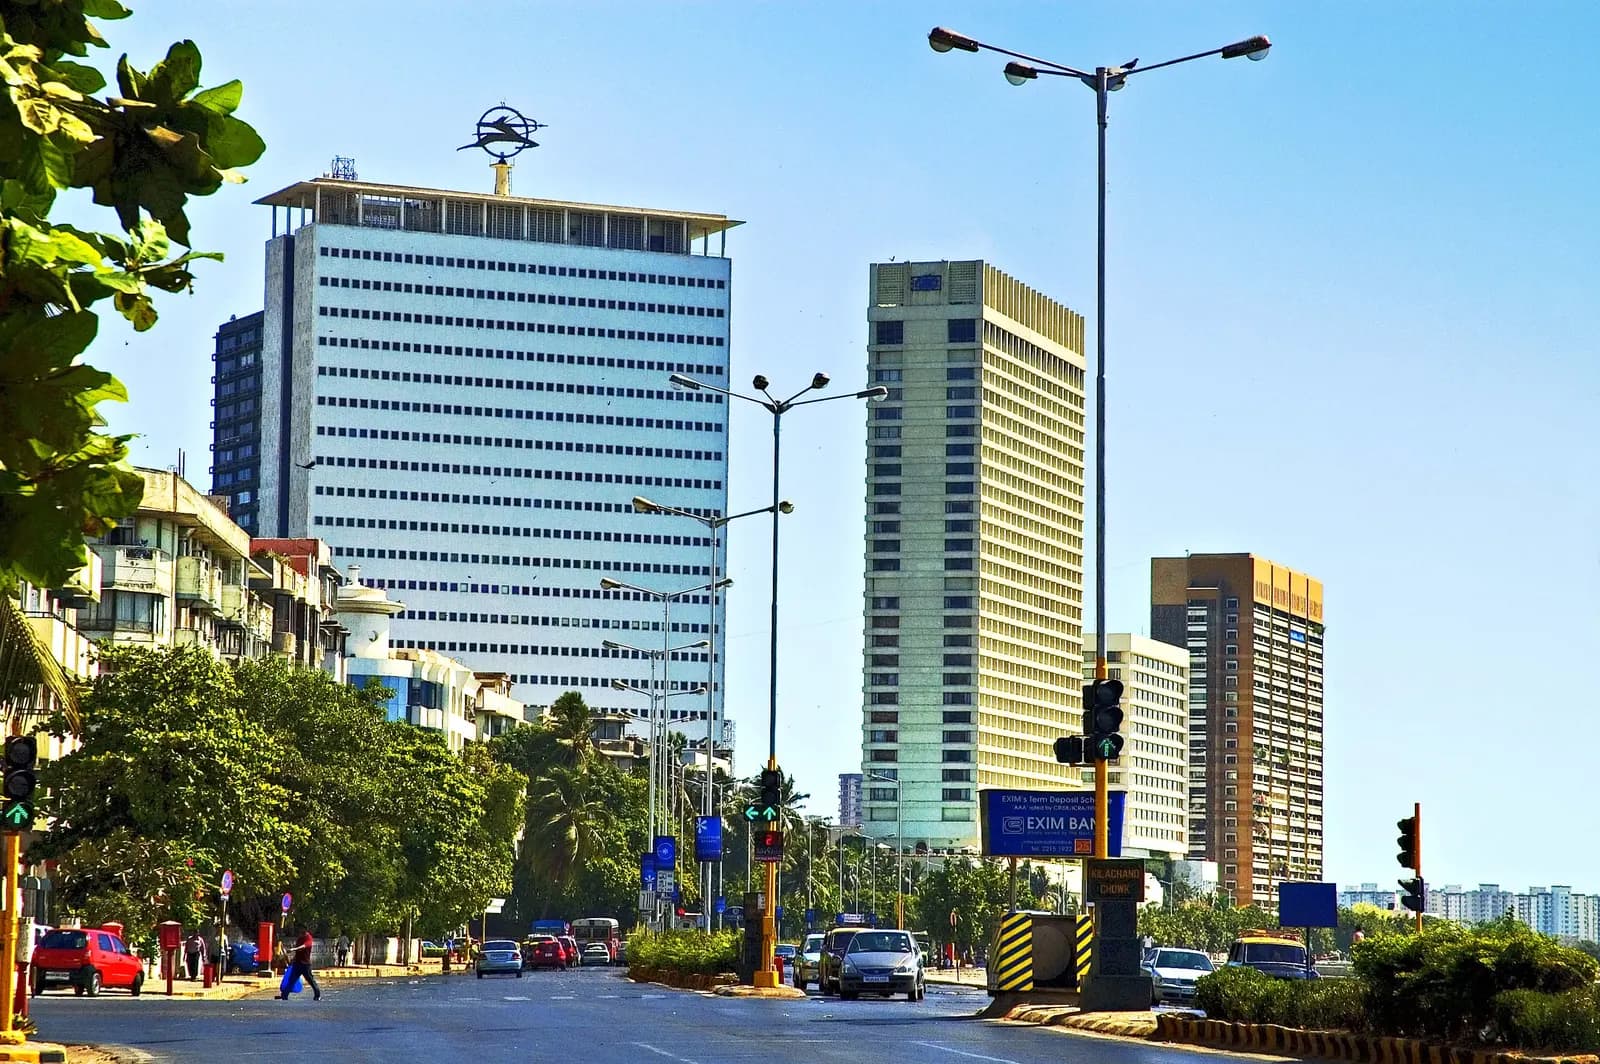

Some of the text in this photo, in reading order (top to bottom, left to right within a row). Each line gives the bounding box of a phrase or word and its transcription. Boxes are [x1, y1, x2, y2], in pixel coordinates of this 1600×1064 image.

[1029, 795, 1048, 803] Term
[1050, 795, 1079, 805] Deposit
[1027, 816, 1111, 831] EXIM BAN
